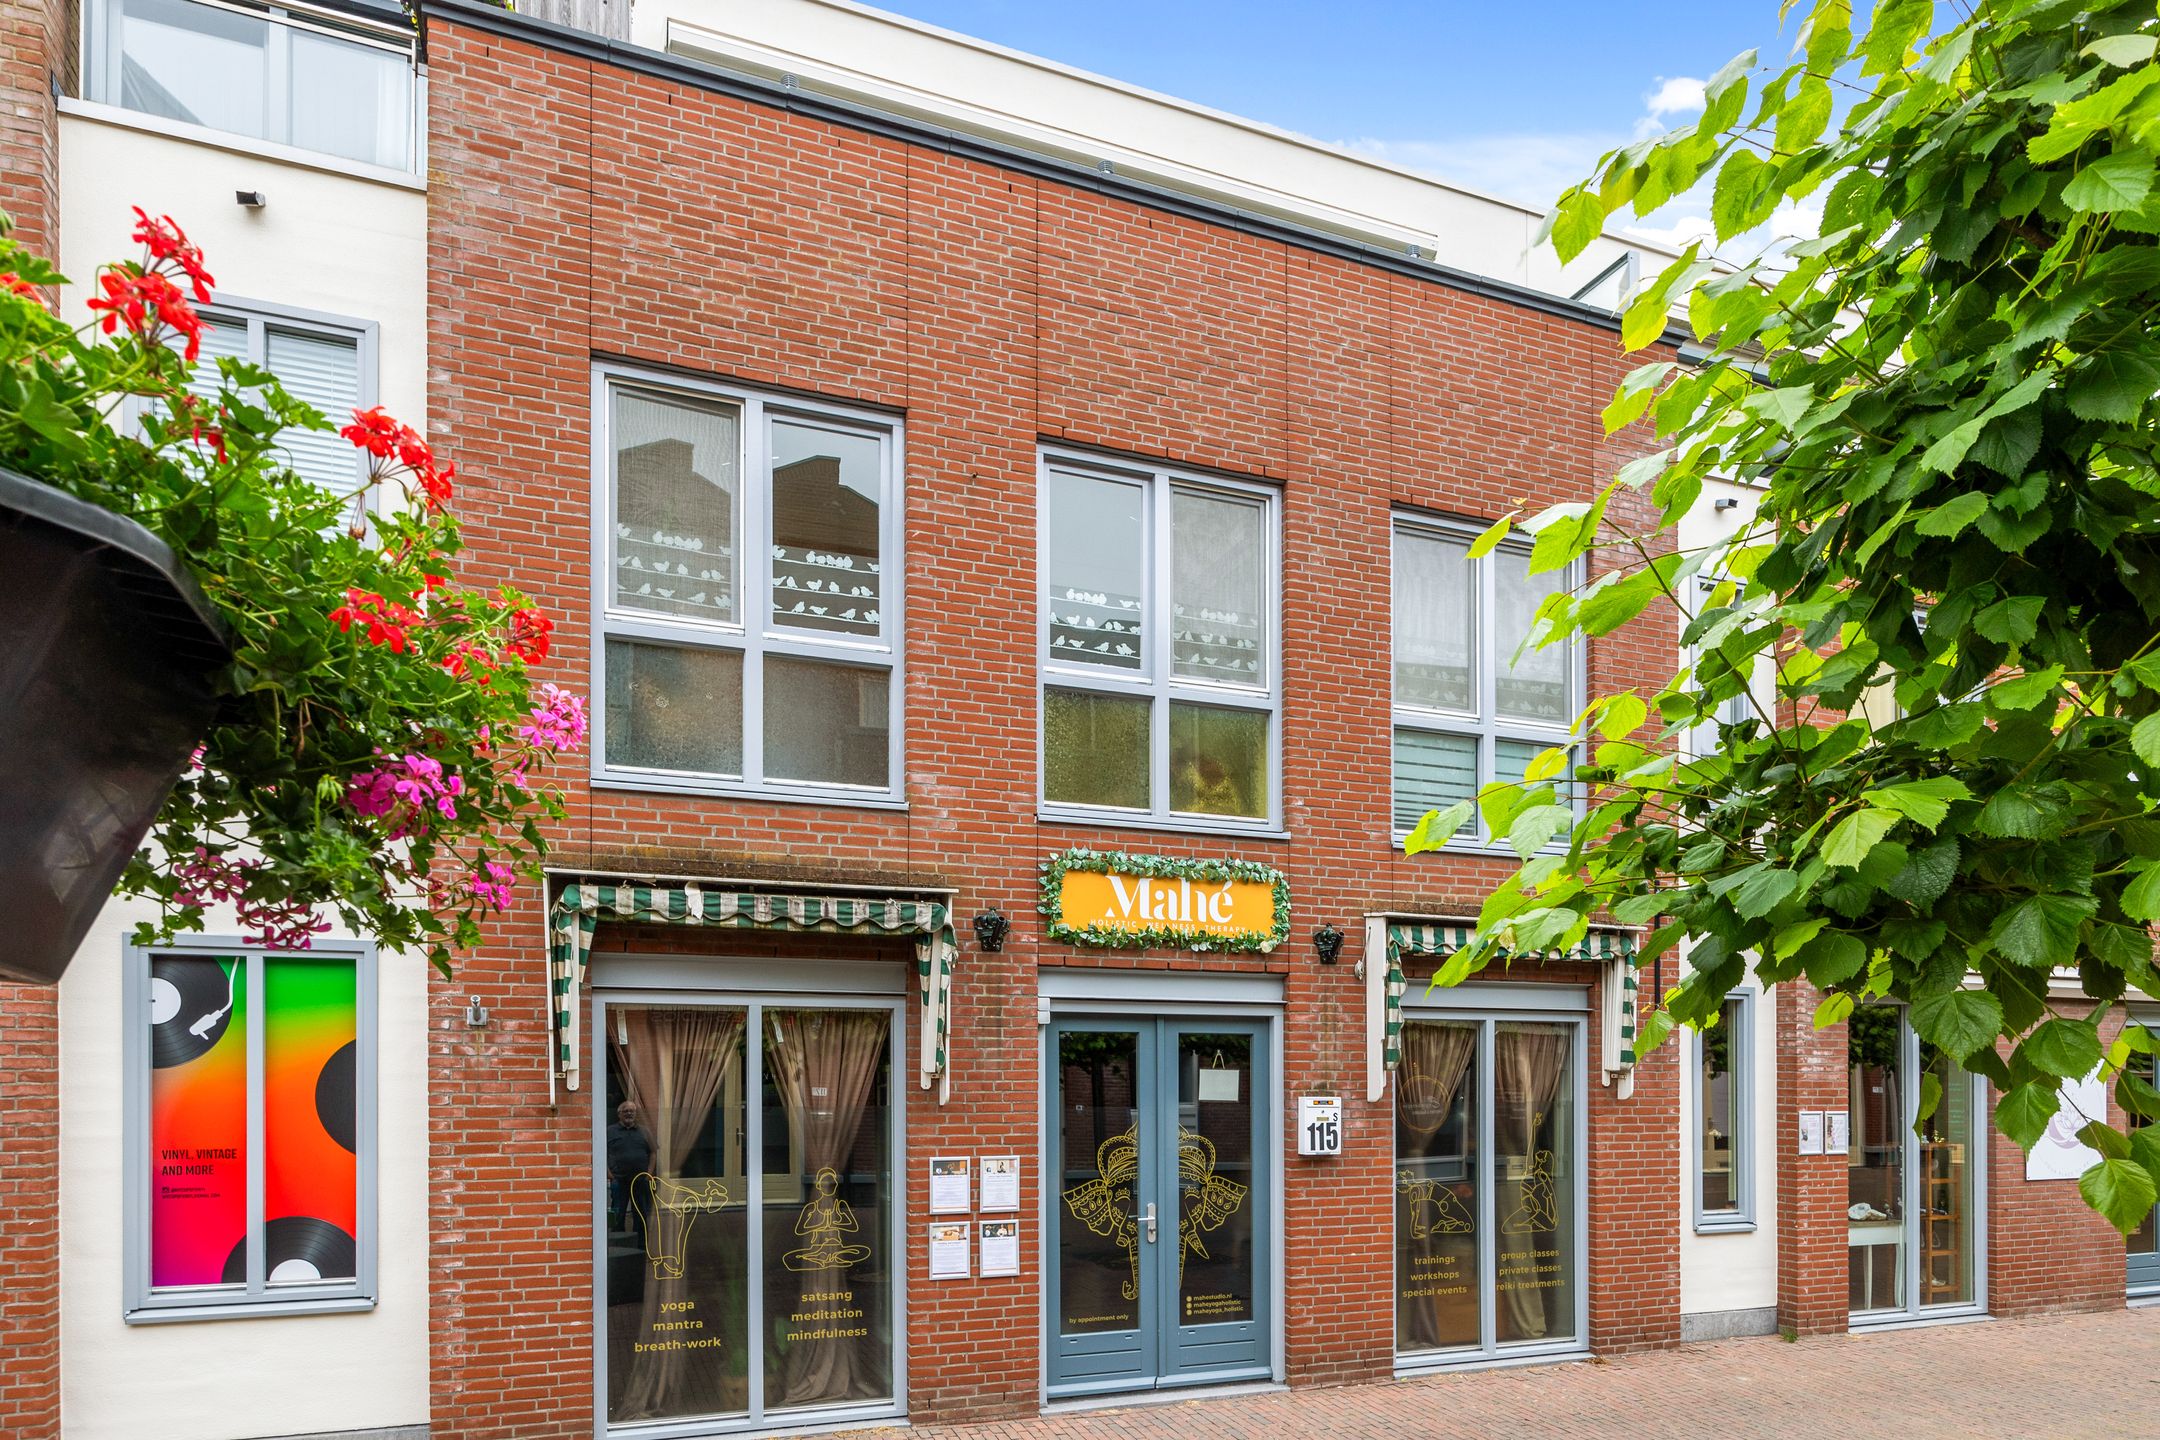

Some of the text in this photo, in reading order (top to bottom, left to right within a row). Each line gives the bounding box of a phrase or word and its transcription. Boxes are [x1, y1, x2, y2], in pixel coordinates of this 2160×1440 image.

[1104, 875, 1233, 923] Mahé
[1090, 919, 1137, 928] HOLISTIC
[1204, 924, 1246, 933] THERAPY
[1333, 1112, 1339, 1122] S
[1307, 1122, 1338, 1151] 115
[161, 1148, 237, 1160] VINYL, VINTAGE
[161, 1164, 215, 1176] AND MORE
[1414, 1255, 1456, 1265] trainings
[1501, 1249, 1560, 1262] group classes
[1410, 1271, 1460, 1280] workshops
[1499, 1264, 1562, 1276] private classes
[1496, 1279, 1566, 1291] reiki treatments
[801, 1291, 852, 1302] satsang
[1402, 1286, 1468, 1299] special events
[660, 1301, 695, 1313] yoga
[791, 1308, 863, 1321] meditation
[1077, 1315, 1116, 1324] appointment
[653, 1320, 703, 1331] mantra
[787, 1328, 868, 1341] mindfulness
[634, 1336, 721, 1352] breath-work
